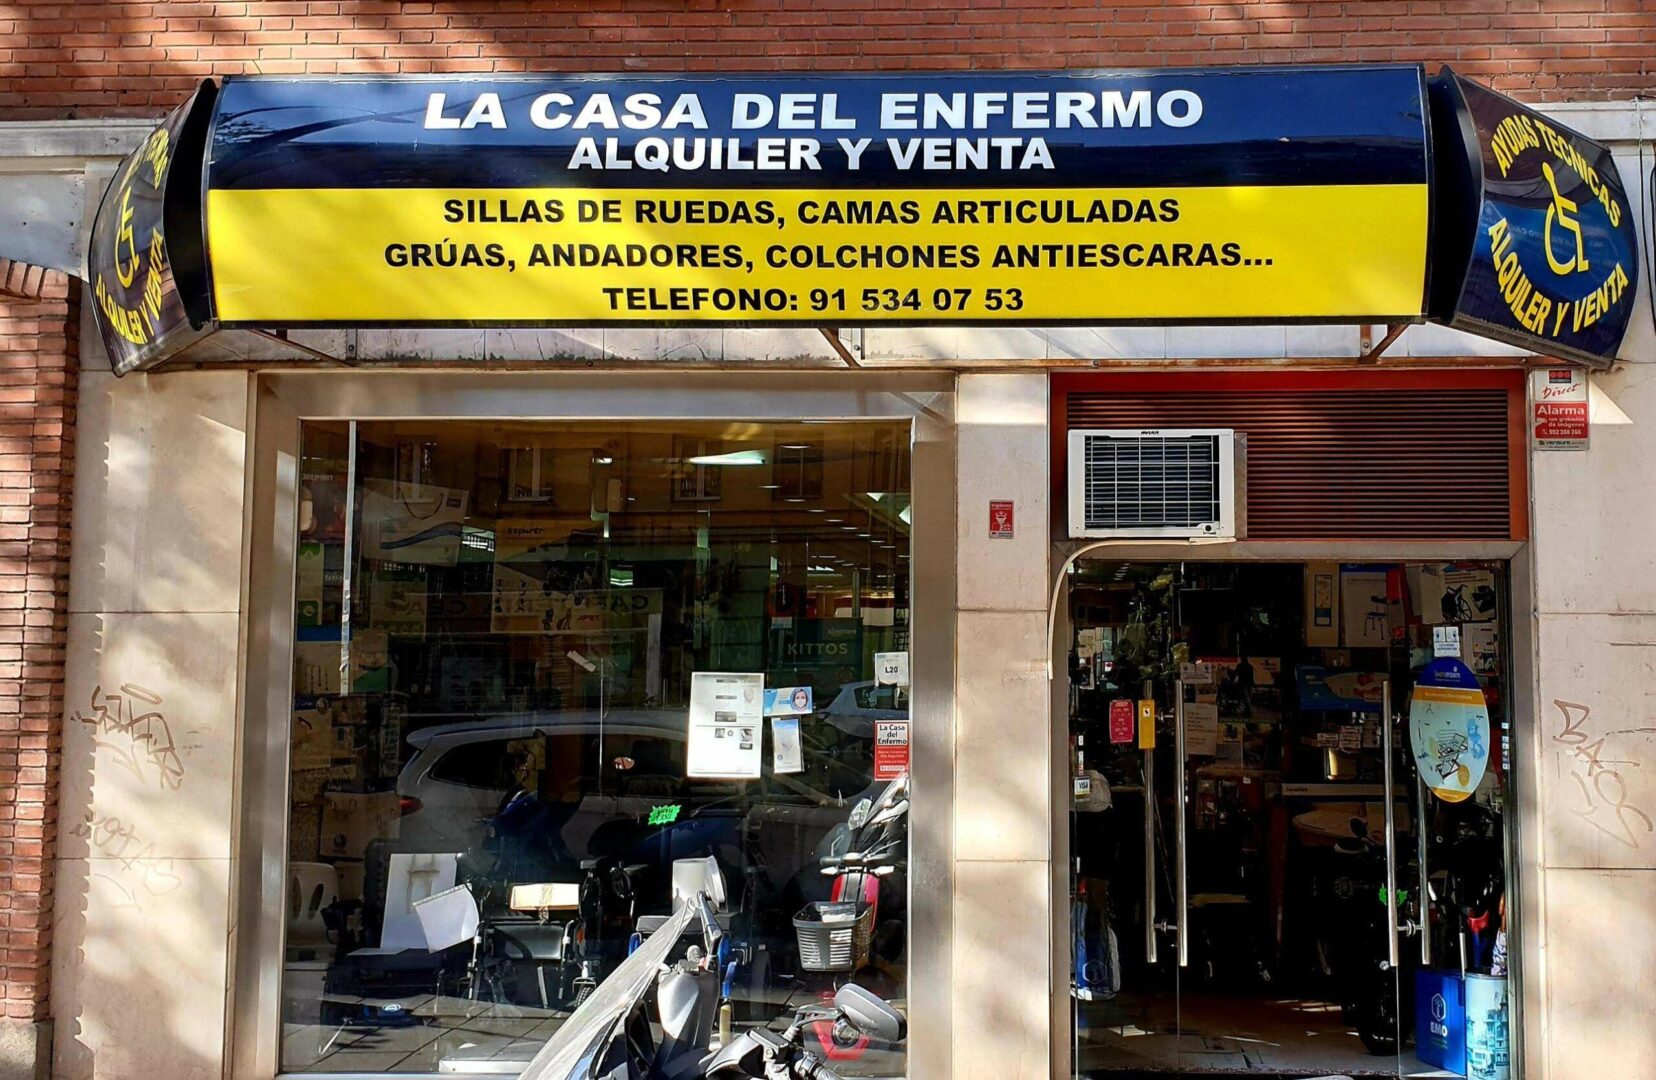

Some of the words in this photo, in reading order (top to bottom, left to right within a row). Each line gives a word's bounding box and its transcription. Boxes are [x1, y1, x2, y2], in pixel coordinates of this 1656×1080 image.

[423, 92, 507, 130] LA
[529, 92, 709, 130] CASA
[732, 92, 856, 130] DEL
[880, 89, 1203, 129] ENFERMO
[567, 137, 822, 173] ALQUILER
[837, 138, 872, 170] Y
[886, 137, 1055, 170] VENTA
[1491, 114, 1540, 178] AYUDAS
[1533, 119, 1621, 228] TECNICAS
[444, 199, 564, 223] SILLAS
[578, 199, 622, 223] DE
[635, 199, 785, 229] RUEDAS,
[798, 199, 920, 224] CAMAS
[931, 198, 1180, 224] ARTICULADAS
[384, 237, 515, 272] GRÚAS,
[528, 243, 753, 273] ANDADORES,
[765, 243, 980, 269] COLCHONES
[991, 242, 1274, 268] ANTIESCARAS...
[1488, 217, 1551, 336] ALQUILER
[1552, 302, 1569, 336] Y
[1572, 262, 1629, 333] VENTA
[95, 273, 148, 345] ALQUILER
[602, 287, 798, 311] TELEFONO:
[809, 288, 845, 312] 91
[861, 288, 922, 312] 534
[932, 288, 972, 311] 07
[984, 288, 1024, 311] 53
[1542, 382, 1582, 399] Direct
[1537, 405, 1585, 415] Alarma
[787, 642, 848, 656] KITTOS
[884, 666, 899, 674] L20
[1430, 1021, 1448, 1037] EMO
